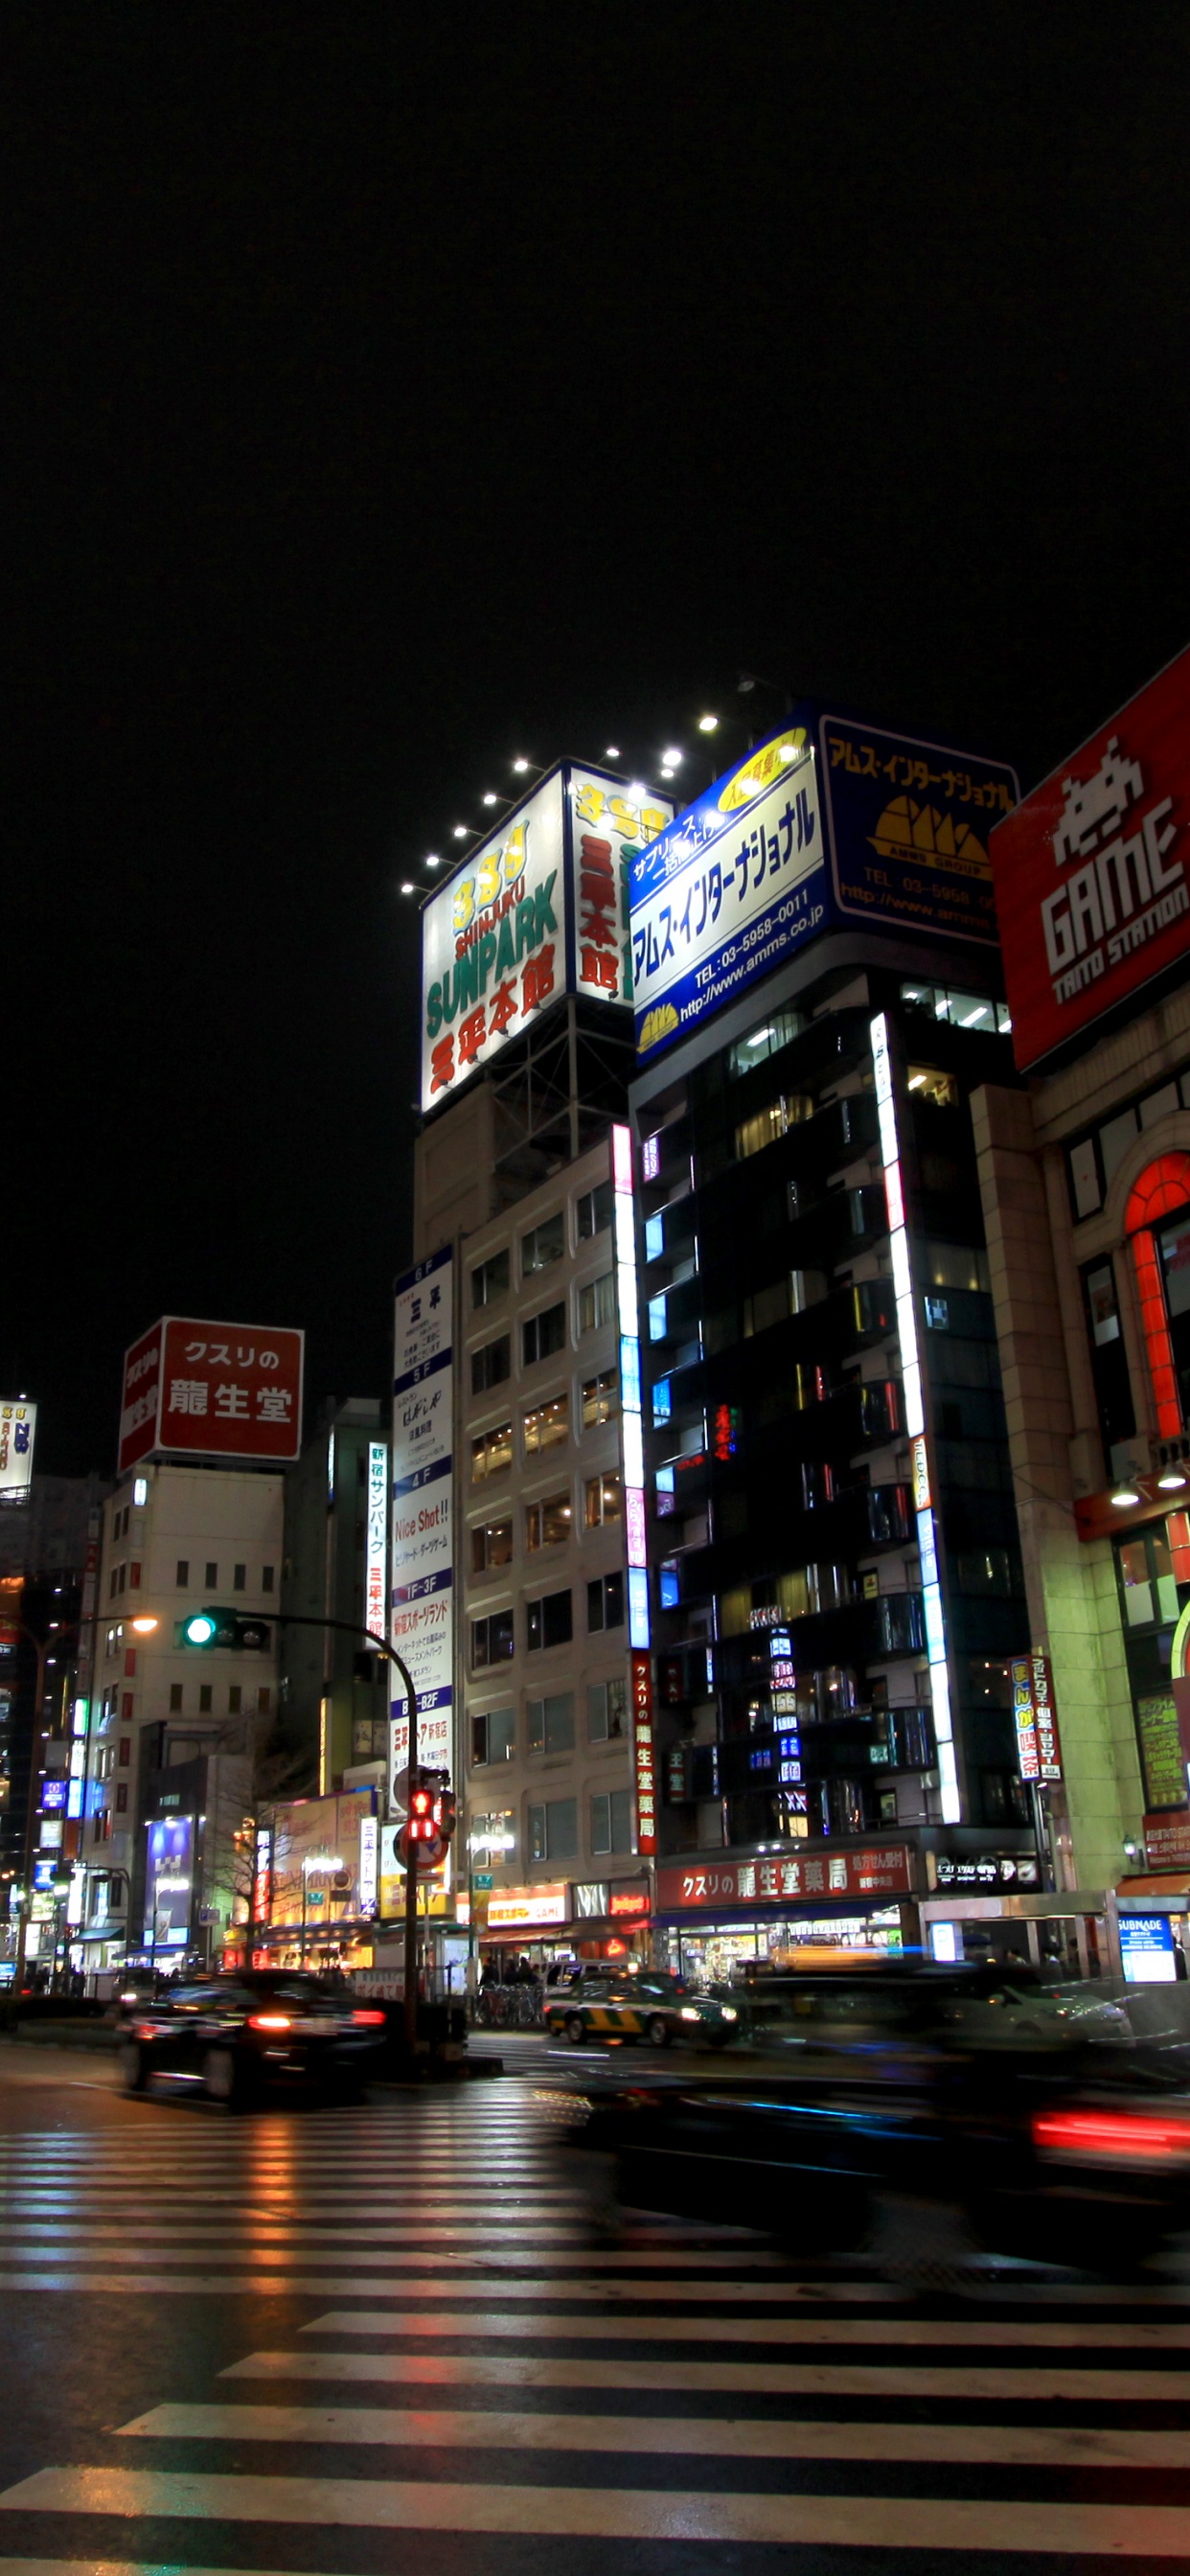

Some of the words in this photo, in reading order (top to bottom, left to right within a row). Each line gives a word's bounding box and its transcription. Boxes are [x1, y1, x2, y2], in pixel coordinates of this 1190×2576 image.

[455, 873, 526, 960] SHINJUKU
[579, 834, 619, 991] 三平本館
[632, 787, 815, 988] アムス・インターナショナル
[1041, 796, 1183, 976] GAME
[1052, 954, 1105, 1005] TAITO
[1107, 882, 1190, 965] STATION
[427, 868, 559, 1039] SUNPARK
[680, 904, 825, 1023] http://www.amms.co.jp
[431, 943, 556, 1094] 三平本館
[168, 1379, 293, 1424] 龍生堂
[184, 1342, 280, 1370] クスリの
[370, 1447, 385, 1553] 新宿サンパーク
[395, 1518, 417, 1543] Nice
[418, 1498, 448, 1532] Shot!!
[1012, 1662, 1039, 1777] まんが喫茶
[1118, 1920, 1163, 1932] SUBNADE
